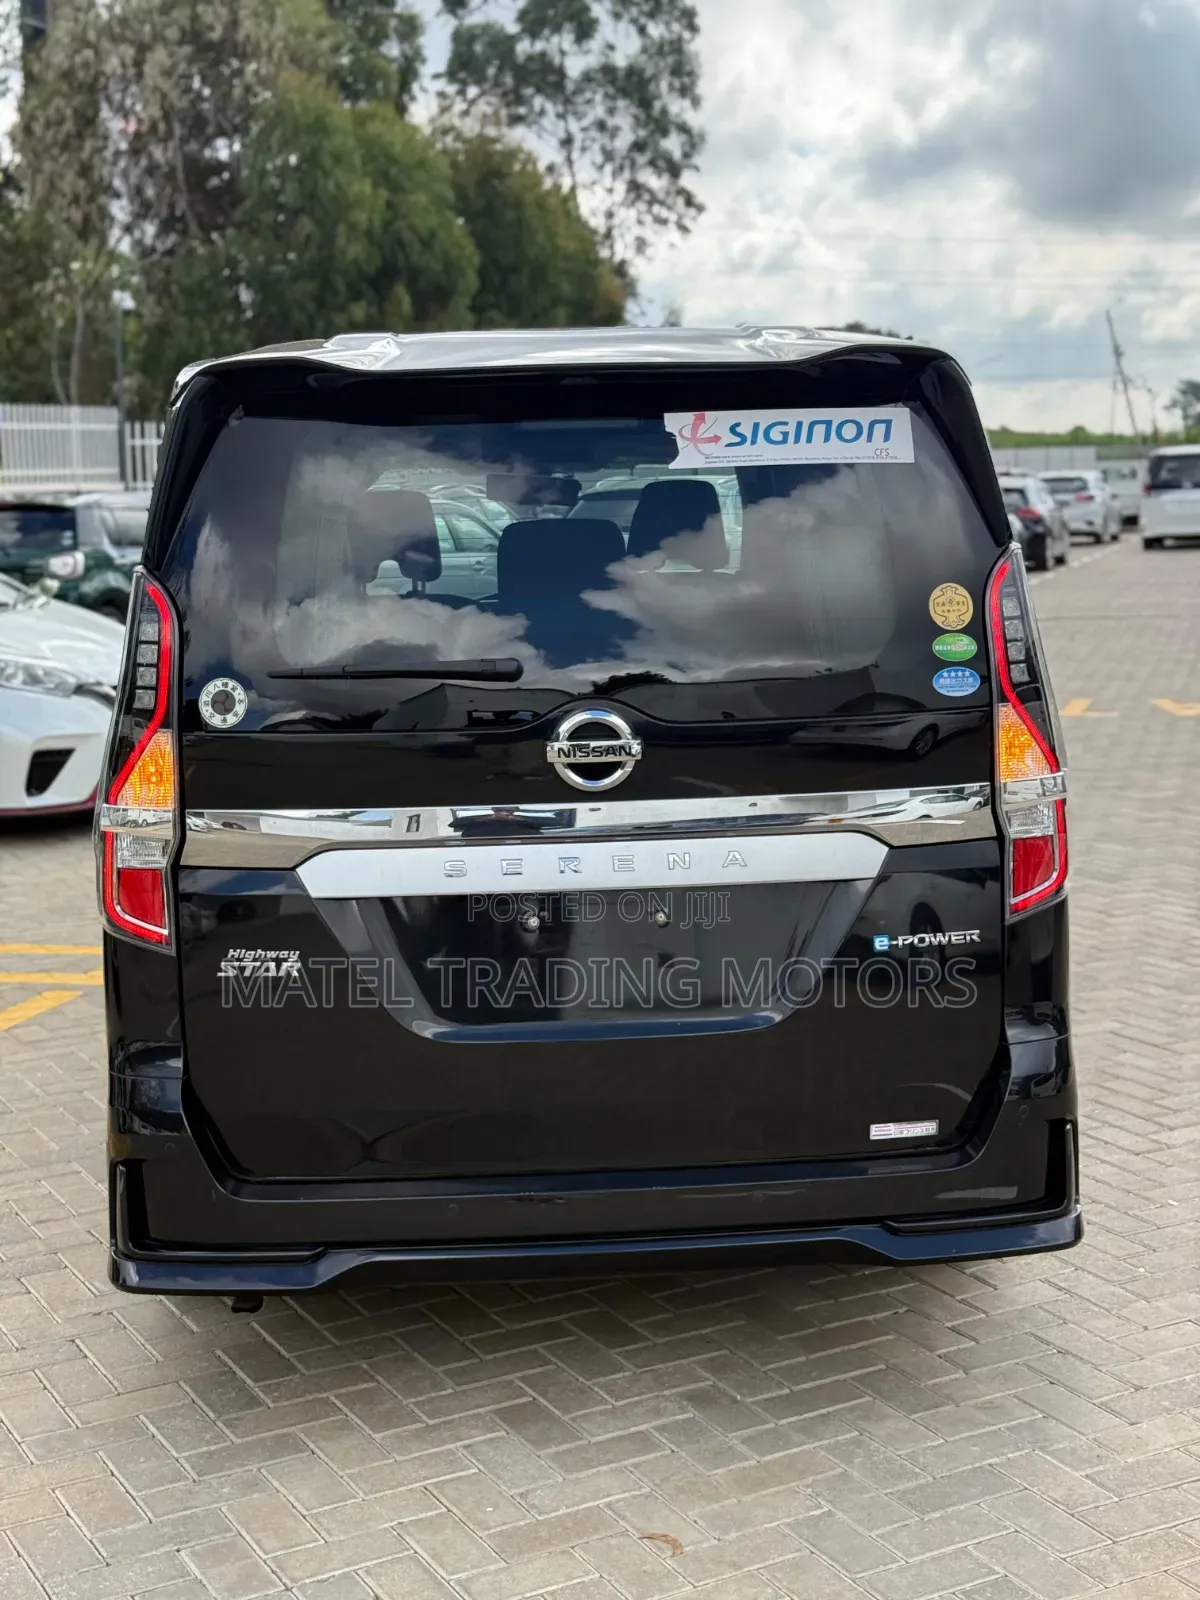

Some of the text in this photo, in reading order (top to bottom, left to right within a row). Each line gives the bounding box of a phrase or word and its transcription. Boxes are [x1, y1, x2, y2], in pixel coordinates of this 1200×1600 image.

[874, 447, 890, 457] CFS
[939, 677, 974, 685] 出ガス
[557, 745, 633, 759] NISSAN
[443, 850, 747, 878] SERENA
[873, 930, 981, 952] e-POWER
[226, 948, 300, 962] Highway
[216, 961, 301, 977] STAR
